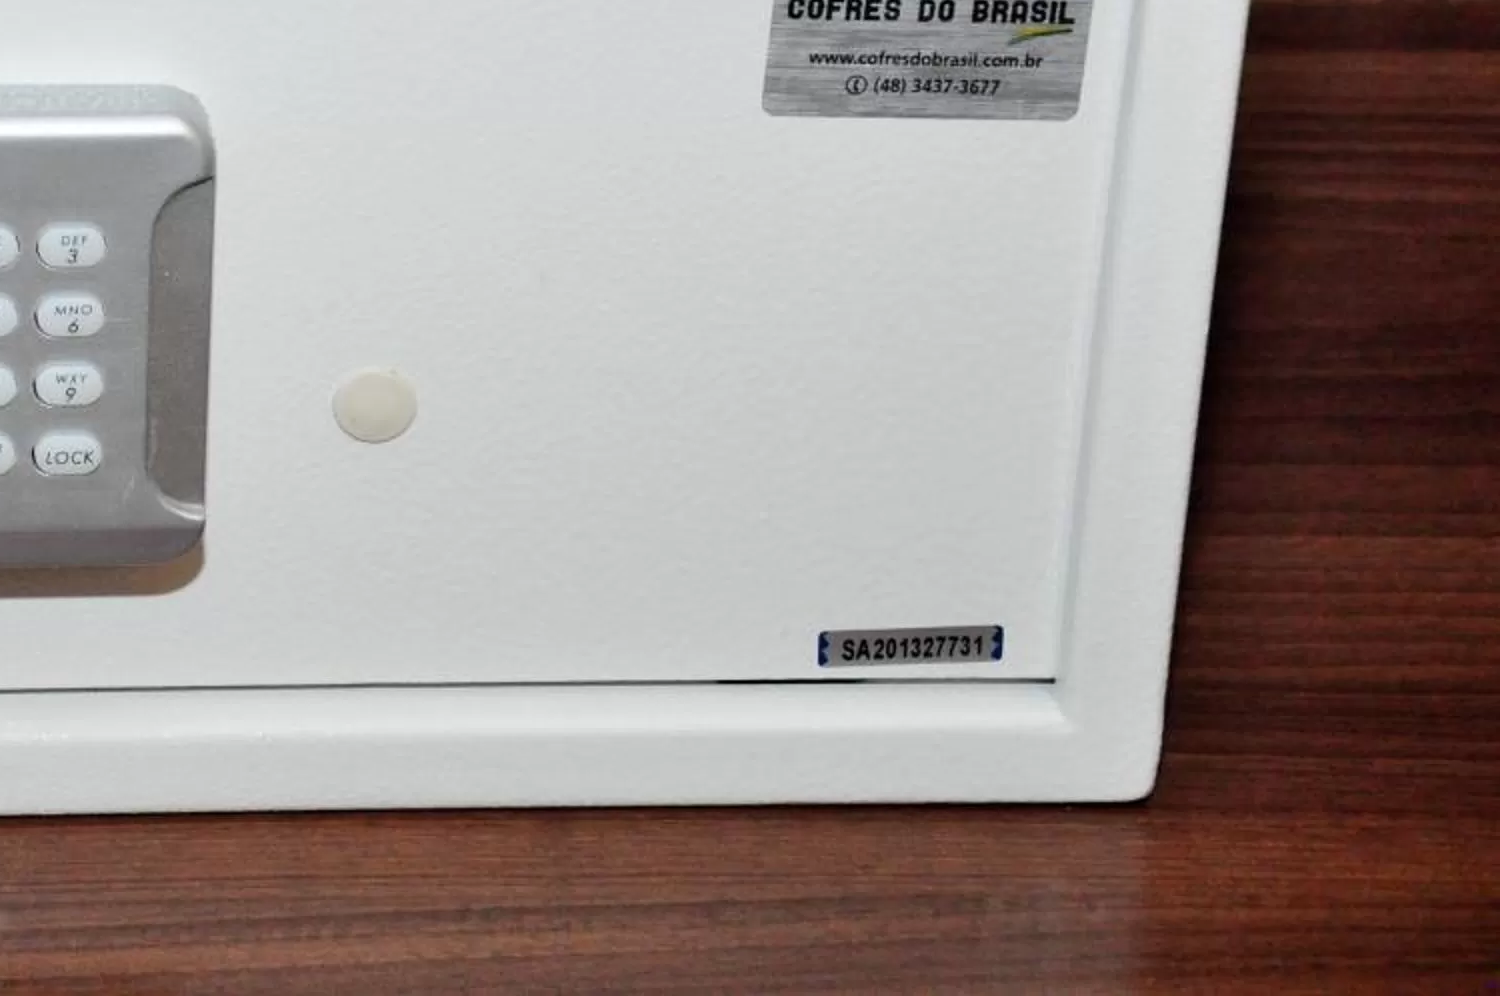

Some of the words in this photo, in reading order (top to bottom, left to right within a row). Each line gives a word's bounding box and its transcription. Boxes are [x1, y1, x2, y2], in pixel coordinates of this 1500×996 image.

[917, 0, 955, 24] DO
[971, 0, 1077, 25] BRASIL
[808, 51, 1044, 69] www.cofresdobrasil.com.br
[873, 77, 907, 95] (48)
[911, 77, 1001, 96] 3437-3677
[60, 235, 88, 247] DEF
[67, 249, 79, 264] 3
[53, 304, 93, 316] MNO
[67, 318, 79, 333] 6
[55, 374, 88, 385] WXY
[65, 387, 77, 402] 9
[45, 450, 95, 465] LOCK
[841, 635, 983, 661] SA201327731
